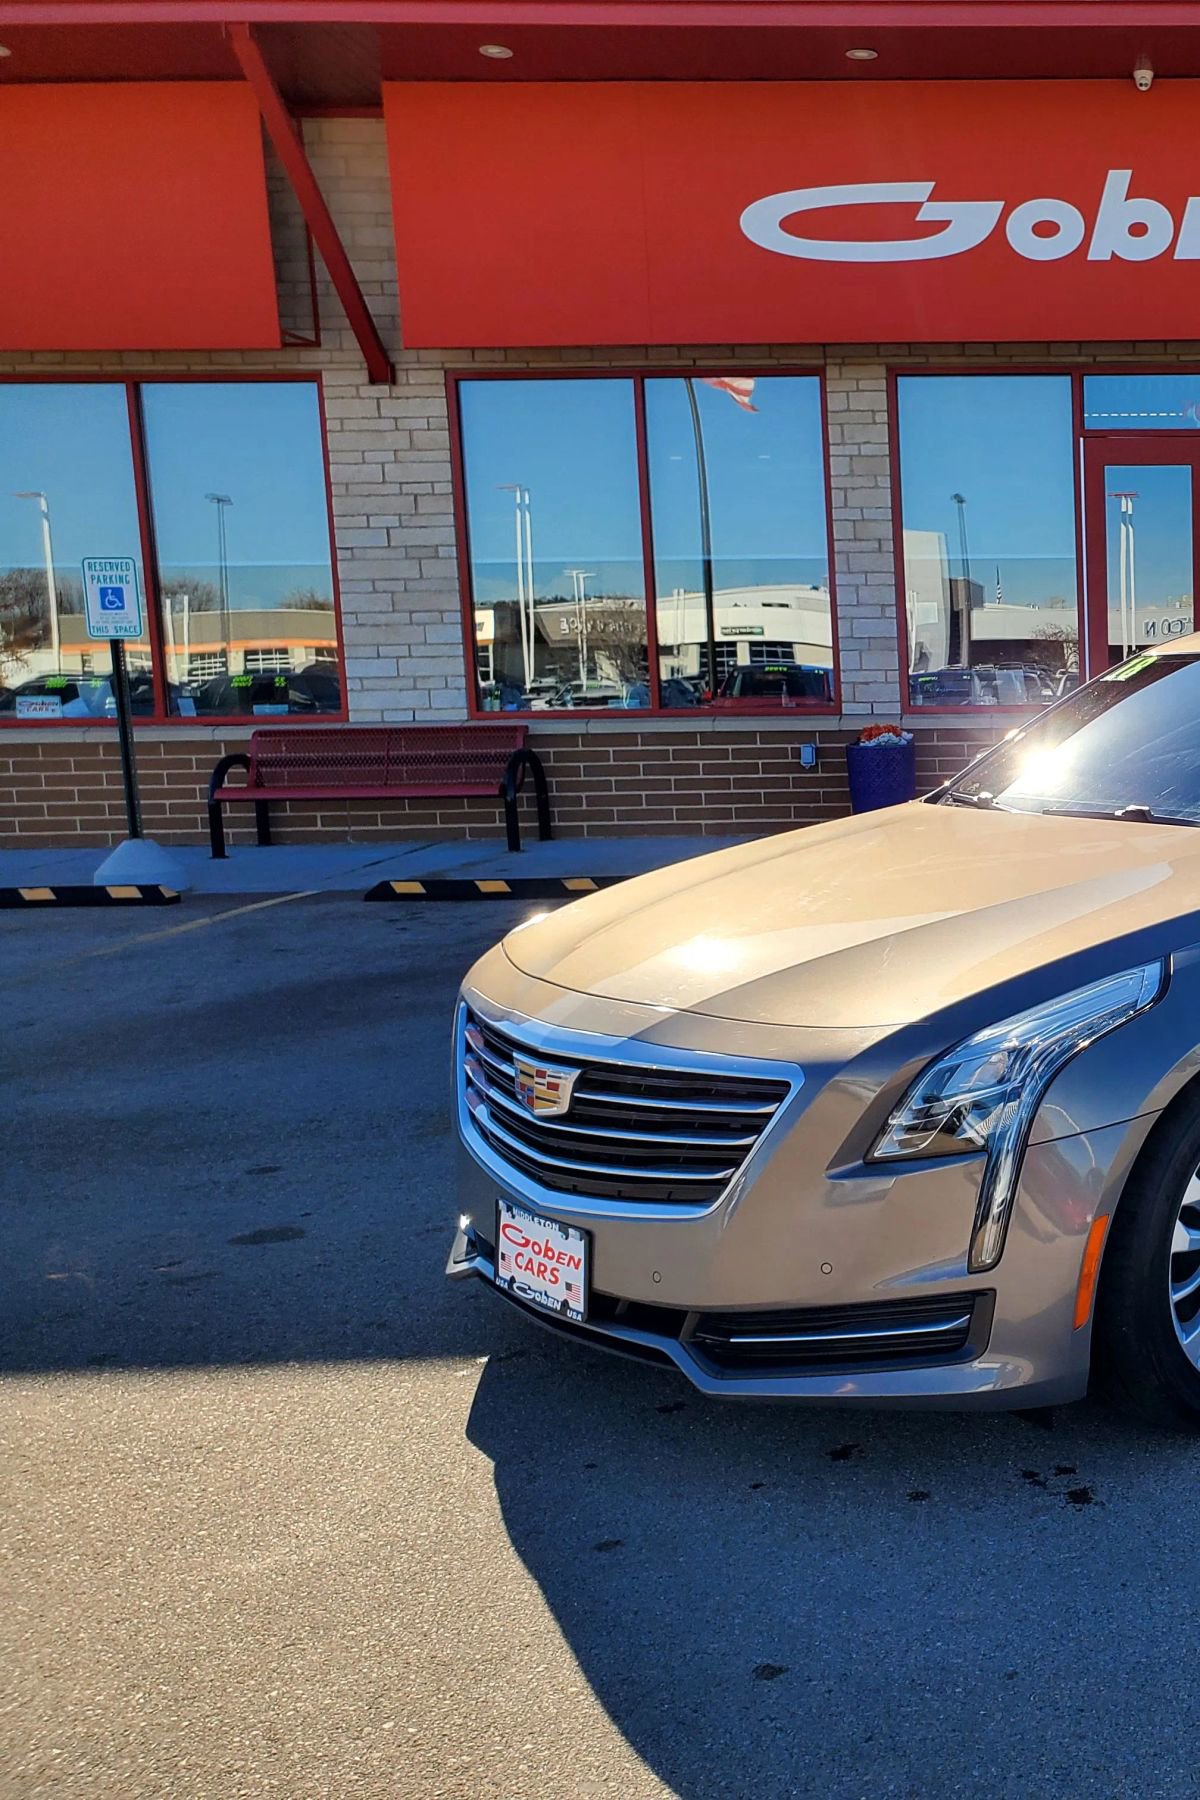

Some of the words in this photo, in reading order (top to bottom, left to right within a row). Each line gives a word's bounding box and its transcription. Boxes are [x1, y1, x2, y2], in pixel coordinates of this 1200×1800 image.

[87, 561, 131, 572] RESERVED
[91, 574, 130, 585] PARKING
[91, 625, 109, 634] THIS
[114, 625, 138, 634] SPACE
[512, 1207, 559, 1231] MIDDLETON
[514, 1252, 560, 1285] CARS
[495, 1278, 509, 1290] USA
[566, 1309, 583, 1322] USA
